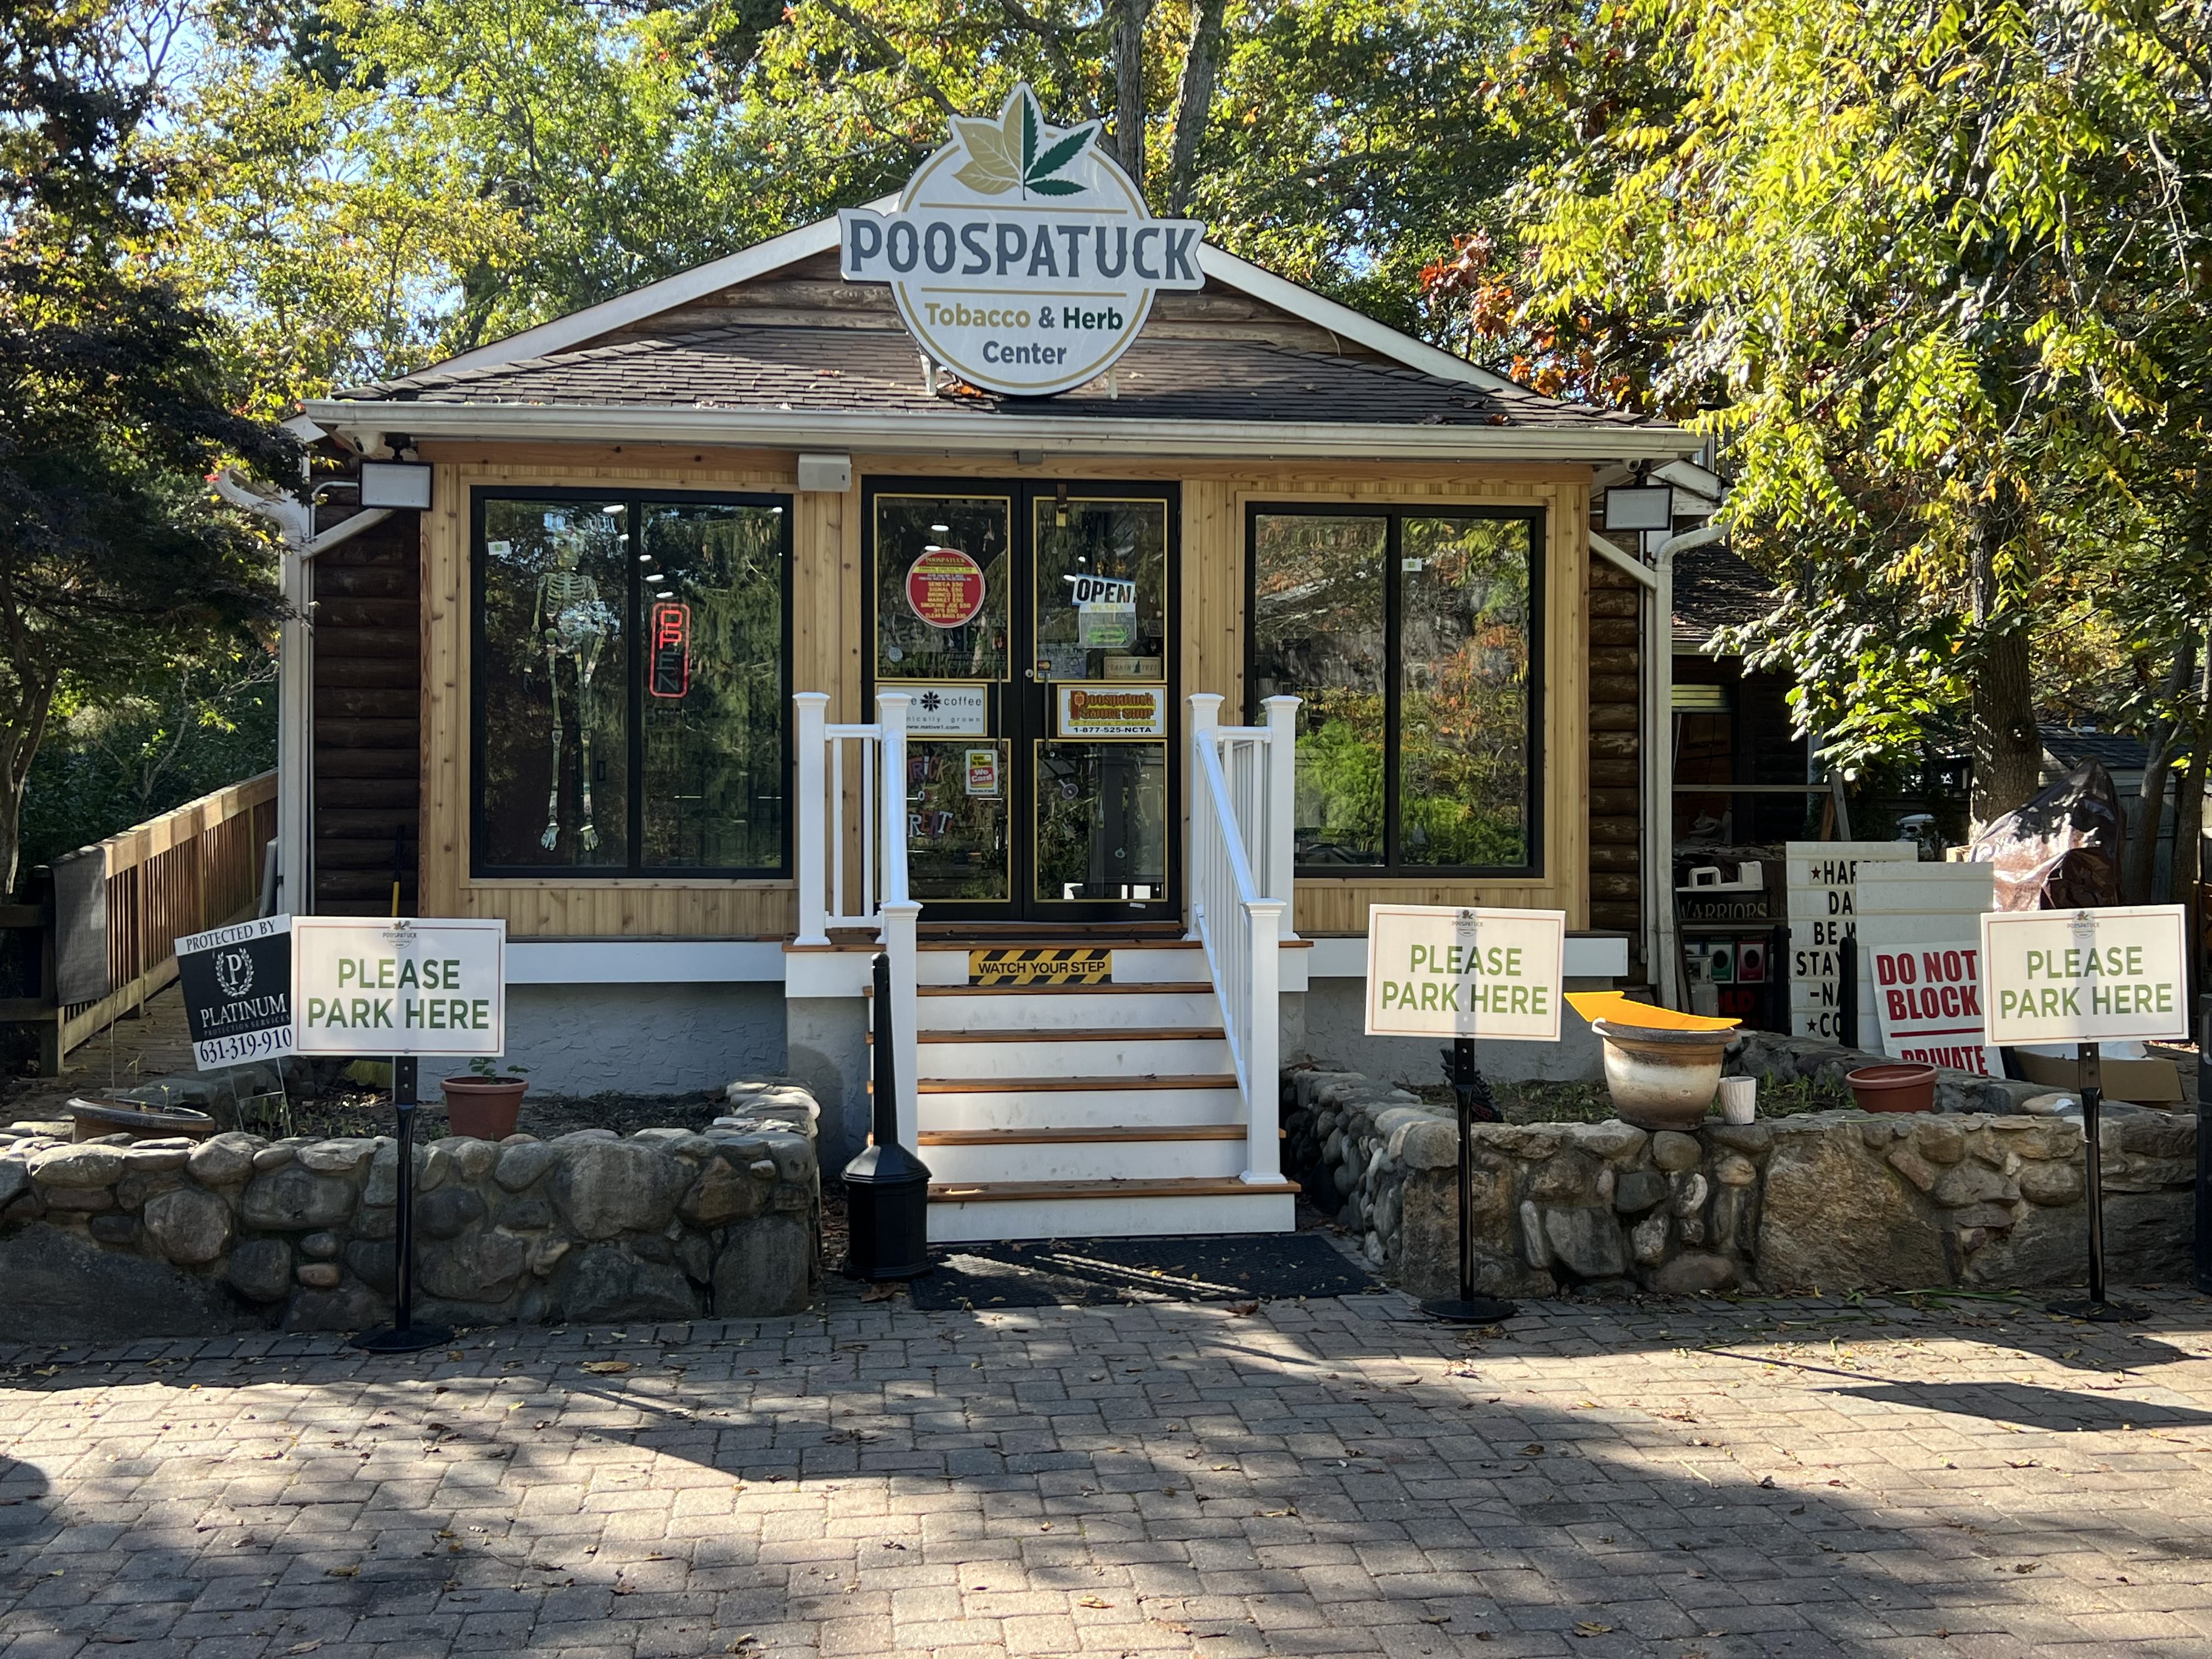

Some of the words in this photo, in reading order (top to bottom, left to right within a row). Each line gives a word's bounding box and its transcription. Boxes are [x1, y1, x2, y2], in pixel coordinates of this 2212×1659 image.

[849, 219, 1197, 280] POOSPATUCK
[924, 302, 1031, 329] Tobacco
[1038, 306, 1055, 329] &
[1063, 306, 1123, 330] Herb
[983, 341, 1067, 364] Center
[1076, 578, 1132, 603] OPEN
[657, 609, 683, 692] OPEN
[944, 696, 982, 707] coffee
[1070, 690, 1155, 720] Poospatuck
[1080, 707, 1121, 719] SMOKE
[1122, 708, 1155, 719] SHOP
[971, 774, 992, 782] Card
[908, 810, 954, 838] REAT
[1680, 900, 1767, 919] WARRIORS
[187, 924, 253, 952] PROTECTED
[259, 920, 275, 935] BY
[1814, 922, 1837, 946] BE
[225, 953, 242, 985] P
[337, 958, 461, 990] PLEASE
[978, 962, 1026, 974] WATCH
[1030, 962, 1069, 974] YOUR
[1071, 961, 1106, 973] STEP
[1410, 944, 1522, 977] PLEASE
[1876, 953, 1917, 986] DO
[1923, 950, 1978, 983] NOT
[2027, 946, 2143, 980] PLEASE
[200, 993, 287, 1028] PLATINUM
[308, 997, 394, 1029] PARK
[405, 998, 489, 1029] HERE
[1382, 981, 1460, 1012] PARK
[1470, 984, 1548, 1015] HERE
[1886, 985, 1982, 1020] BLOCK
[2000, 987, 2081, 1019] PARK
[2092, 983, 2173, 1015] HERE
[204, 1022, 249, 1037] PROTECTION
[251, 1014, 291, 1028] SERVICES
